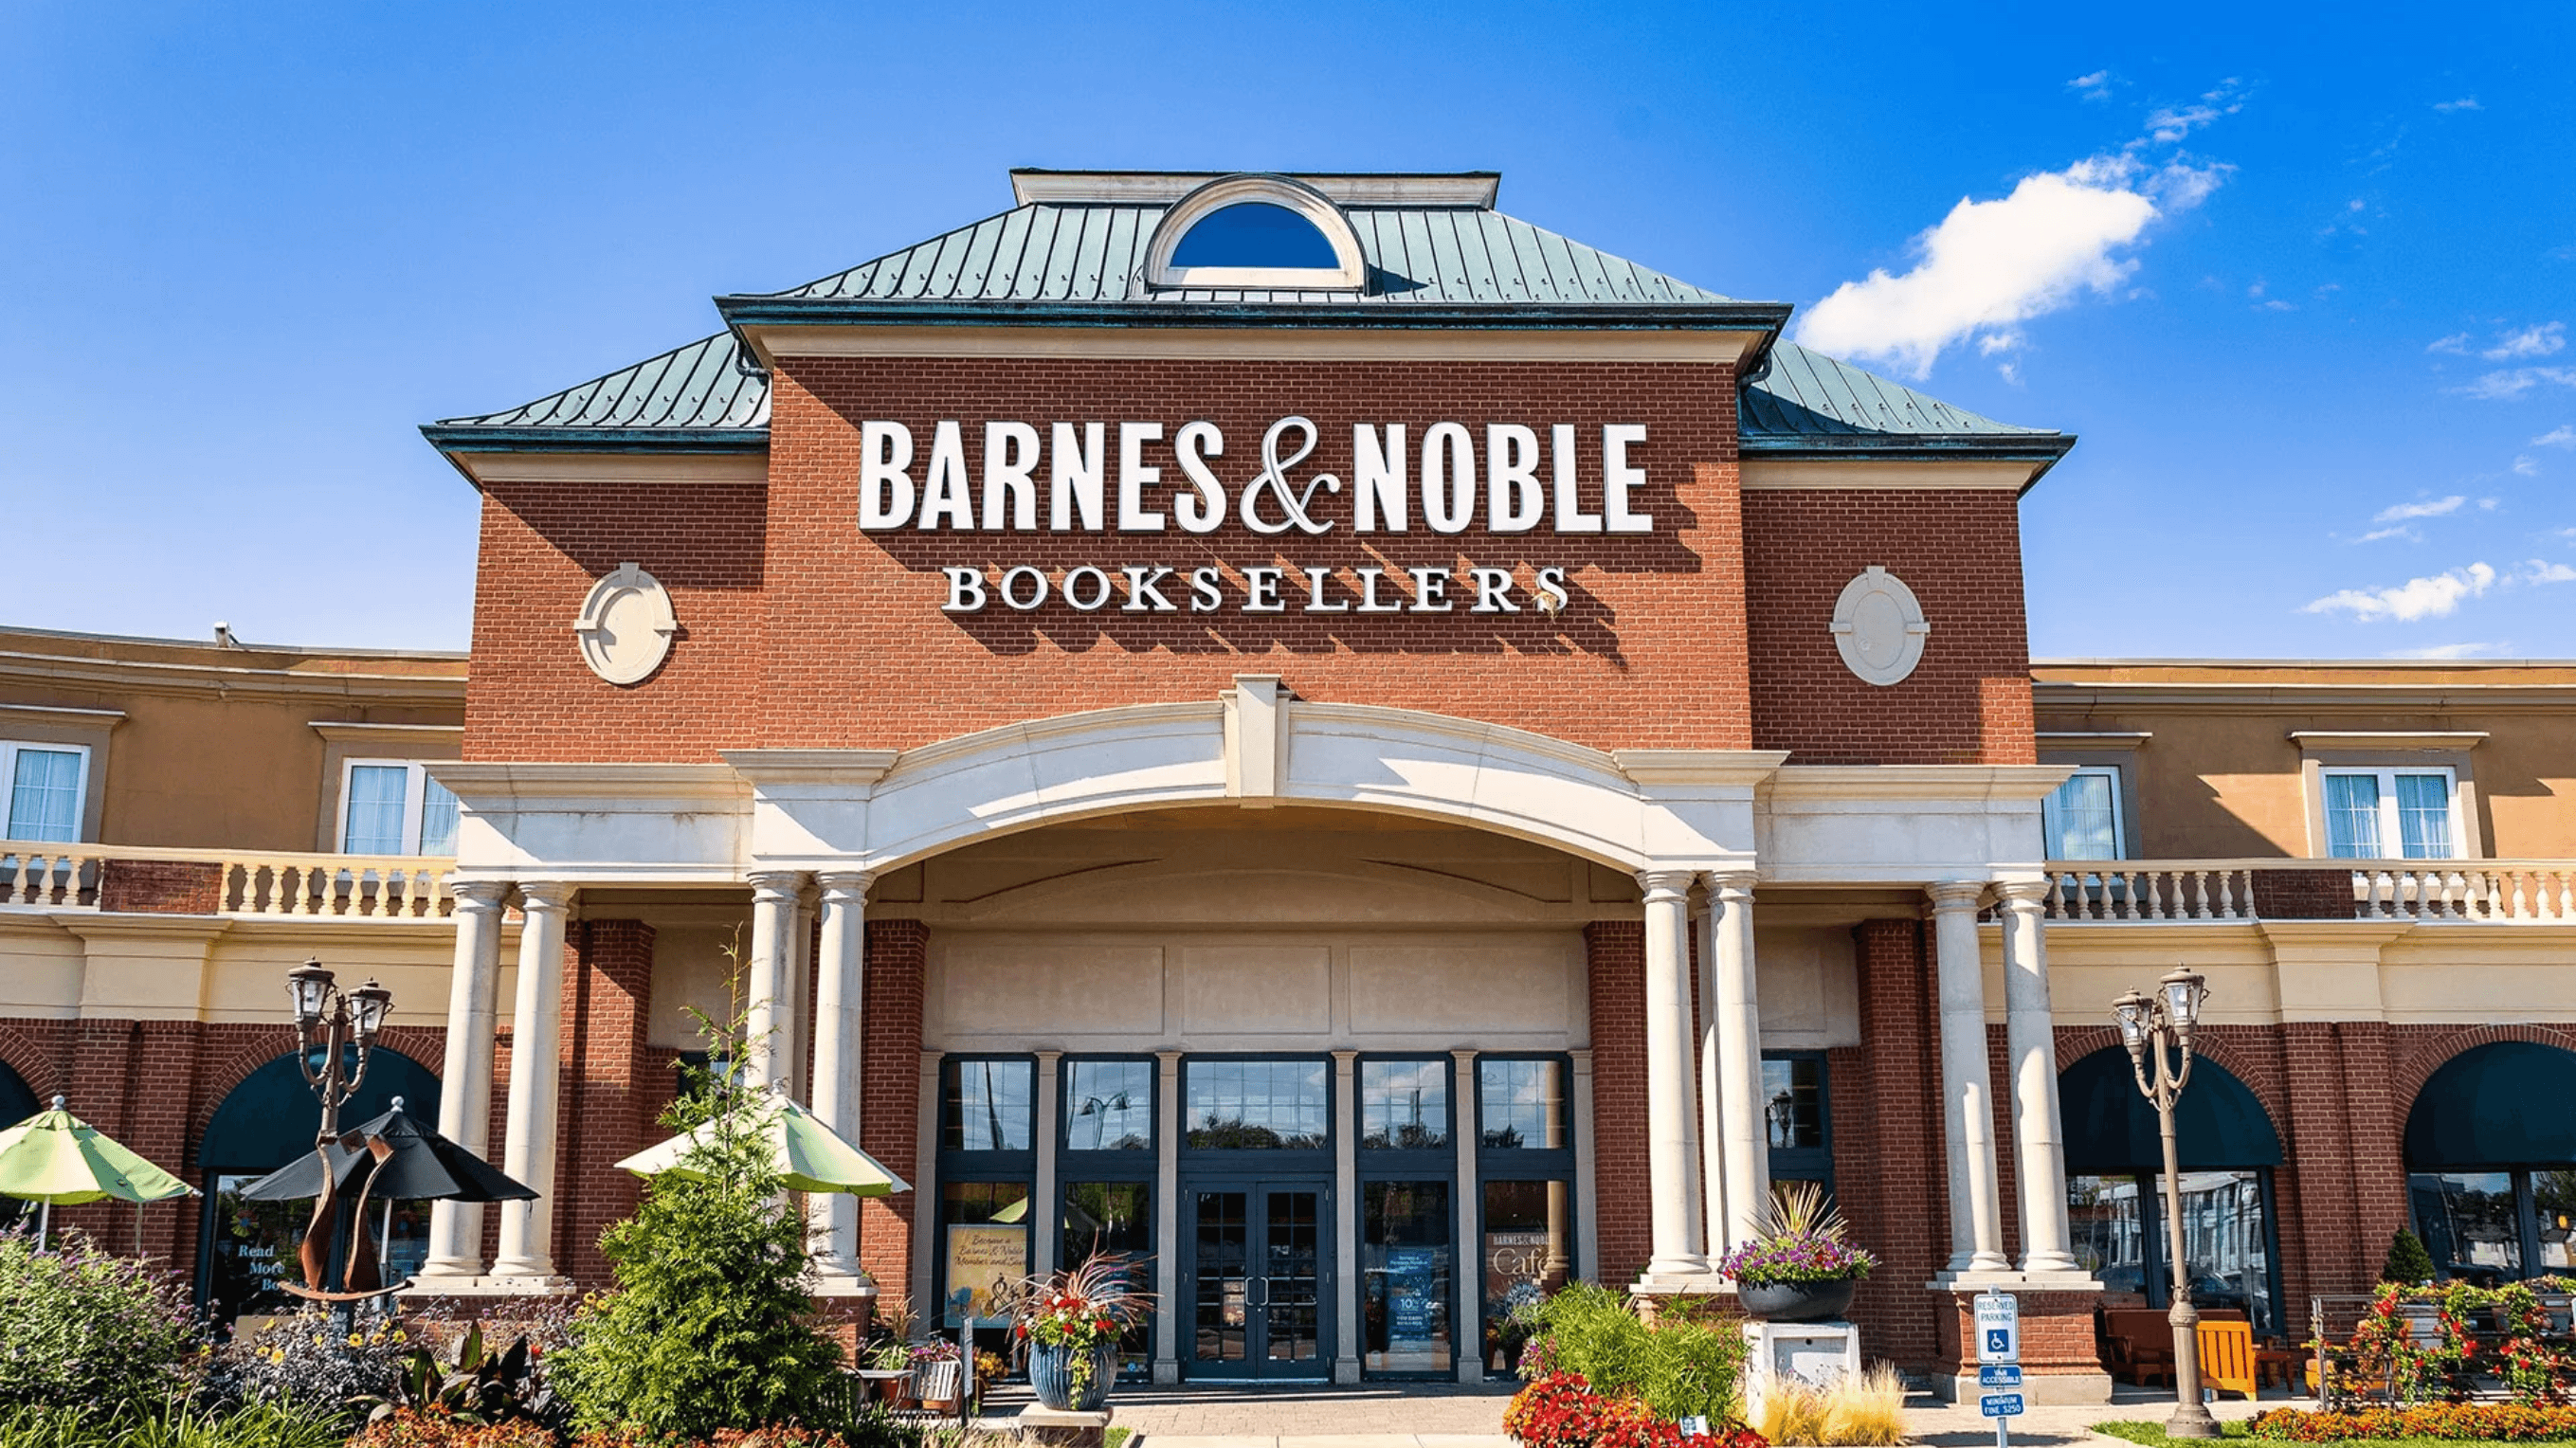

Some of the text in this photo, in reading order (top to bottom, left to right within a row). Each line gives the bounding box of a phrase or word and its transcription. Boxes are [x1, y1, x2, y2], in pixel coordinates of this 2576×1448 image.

[941, 565, 1569, 614] BOOKSELLERS
[238, 1244, 275, 1258] Read
[249, 1262, 285, 1276] More
[1977, 1301, 2014, 1311] RESERVED
[1980, 1312, 2013, 1322] PARKING
[1982, 1375, 2020, 1384] ACCESSIBLE
[1985, 1396, 2018, 1406] MINIMUM
[1984, 1404, 2022, 1415] FINE $250
